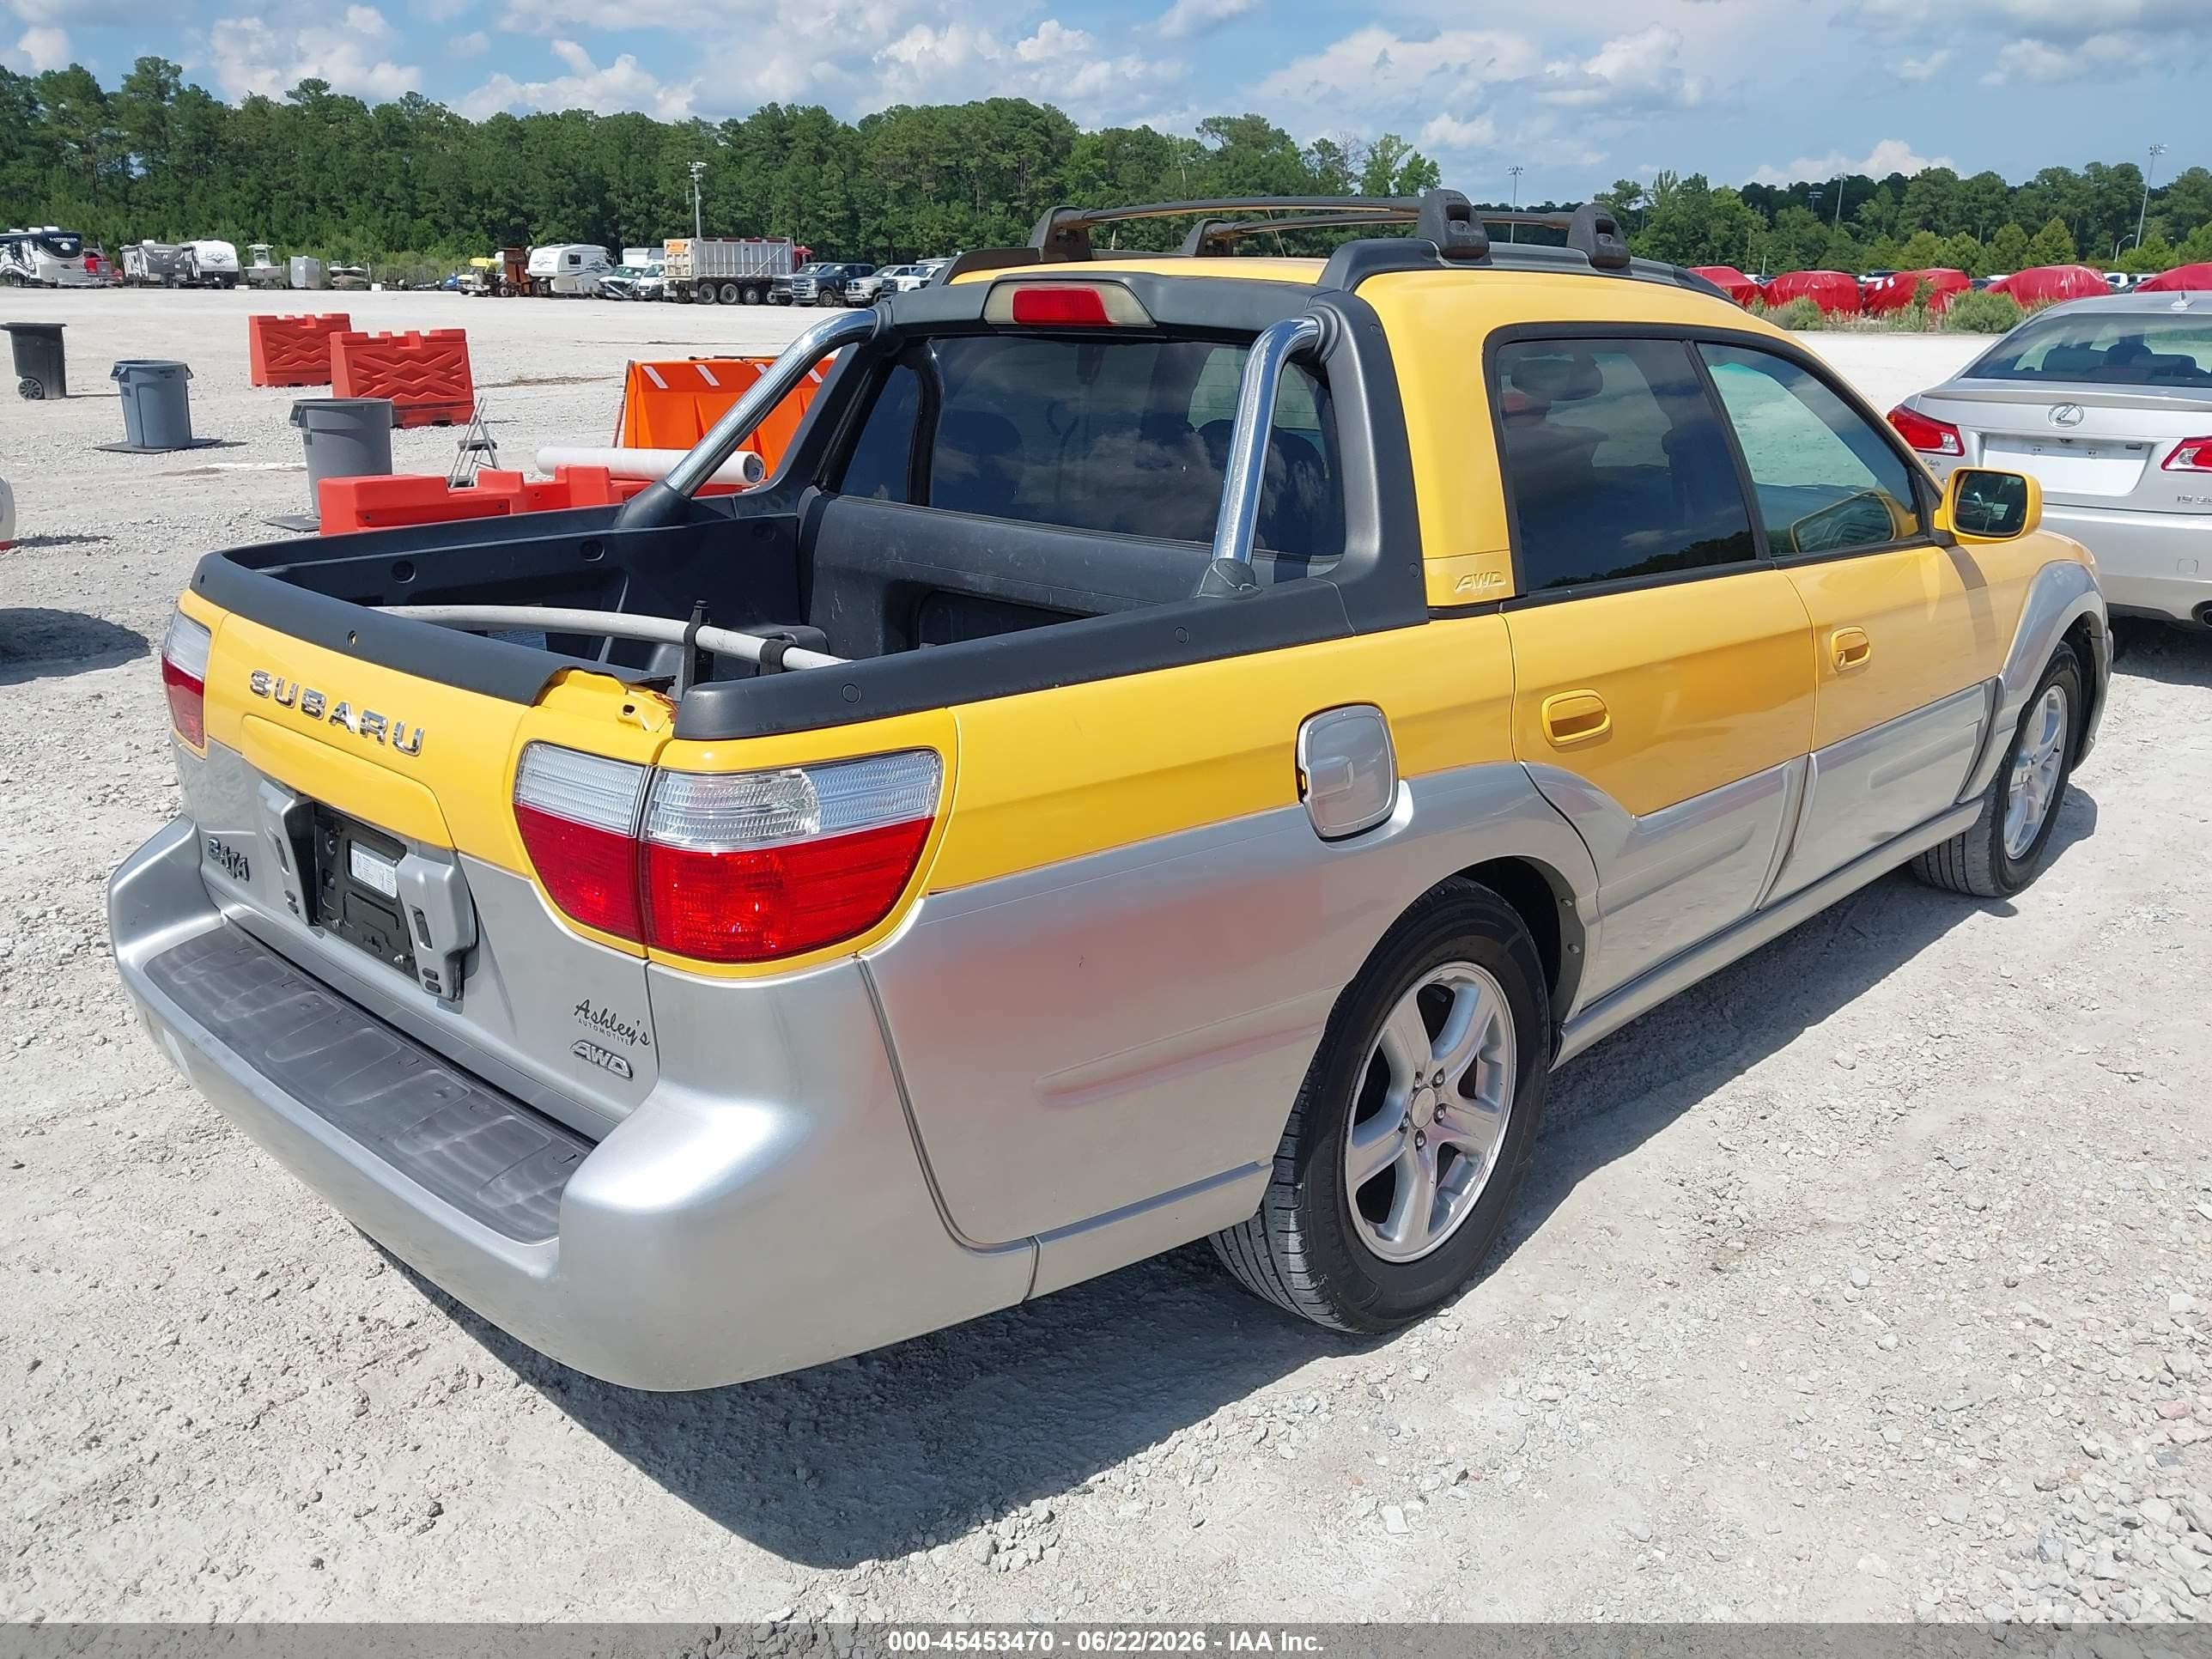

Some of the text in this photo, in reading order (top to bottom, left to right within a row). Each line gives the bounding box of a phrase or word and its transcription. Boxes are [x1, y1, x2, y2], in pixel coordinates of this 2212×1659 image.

[1455, 570, 1506, 592] AWD
[249, 668, 426, 757] SUBARU
[208, 836, 251, 883] BAJA
[574, 998, 651, 1047] Ashley's
[578, 1018, 630, 1046] AUTOMOTIVE
[569, 1039, 634, 1080] AWD
